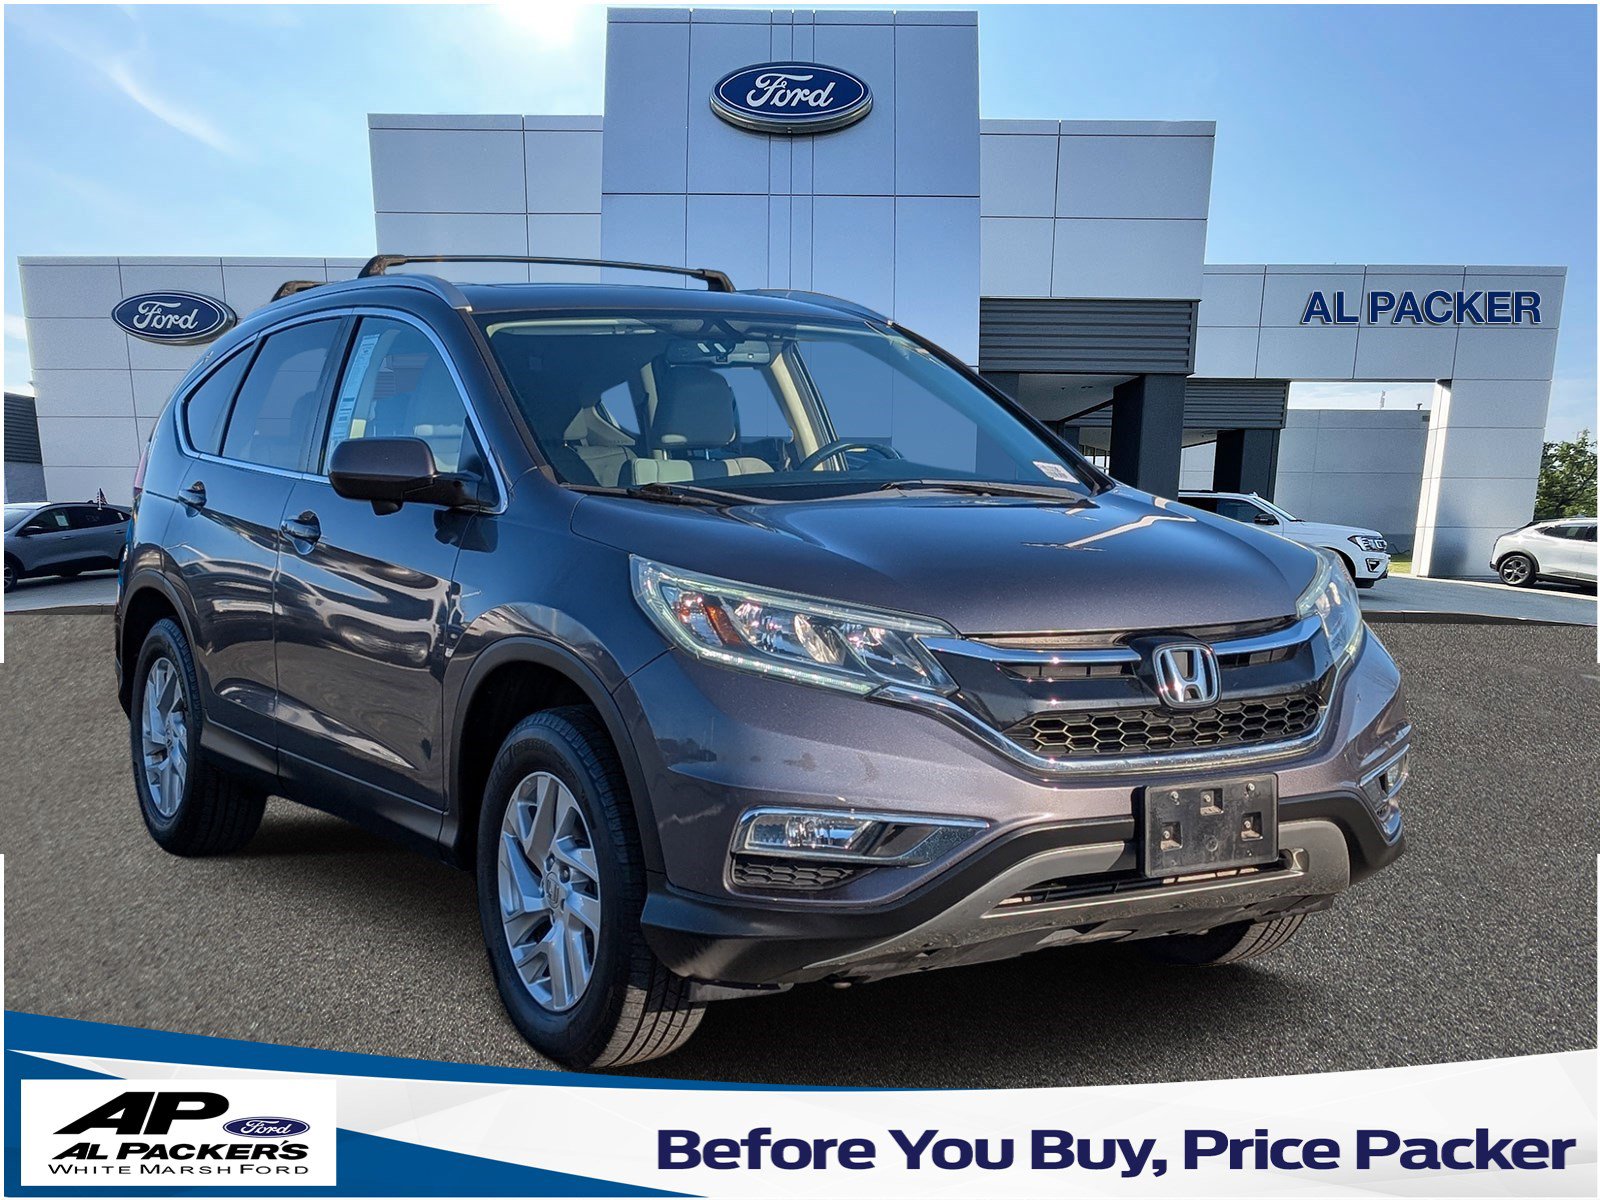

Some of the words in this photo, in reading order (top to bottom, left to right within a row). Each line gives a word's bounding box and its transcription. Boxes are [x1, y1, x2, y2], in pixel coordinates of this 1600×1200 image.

[746, 73, 836, 107] Ford
[133, 301, 199, 329] Ford
[1302, 291, 1359, 324] AL
[1369, 290, 1542, 324] PACKER
